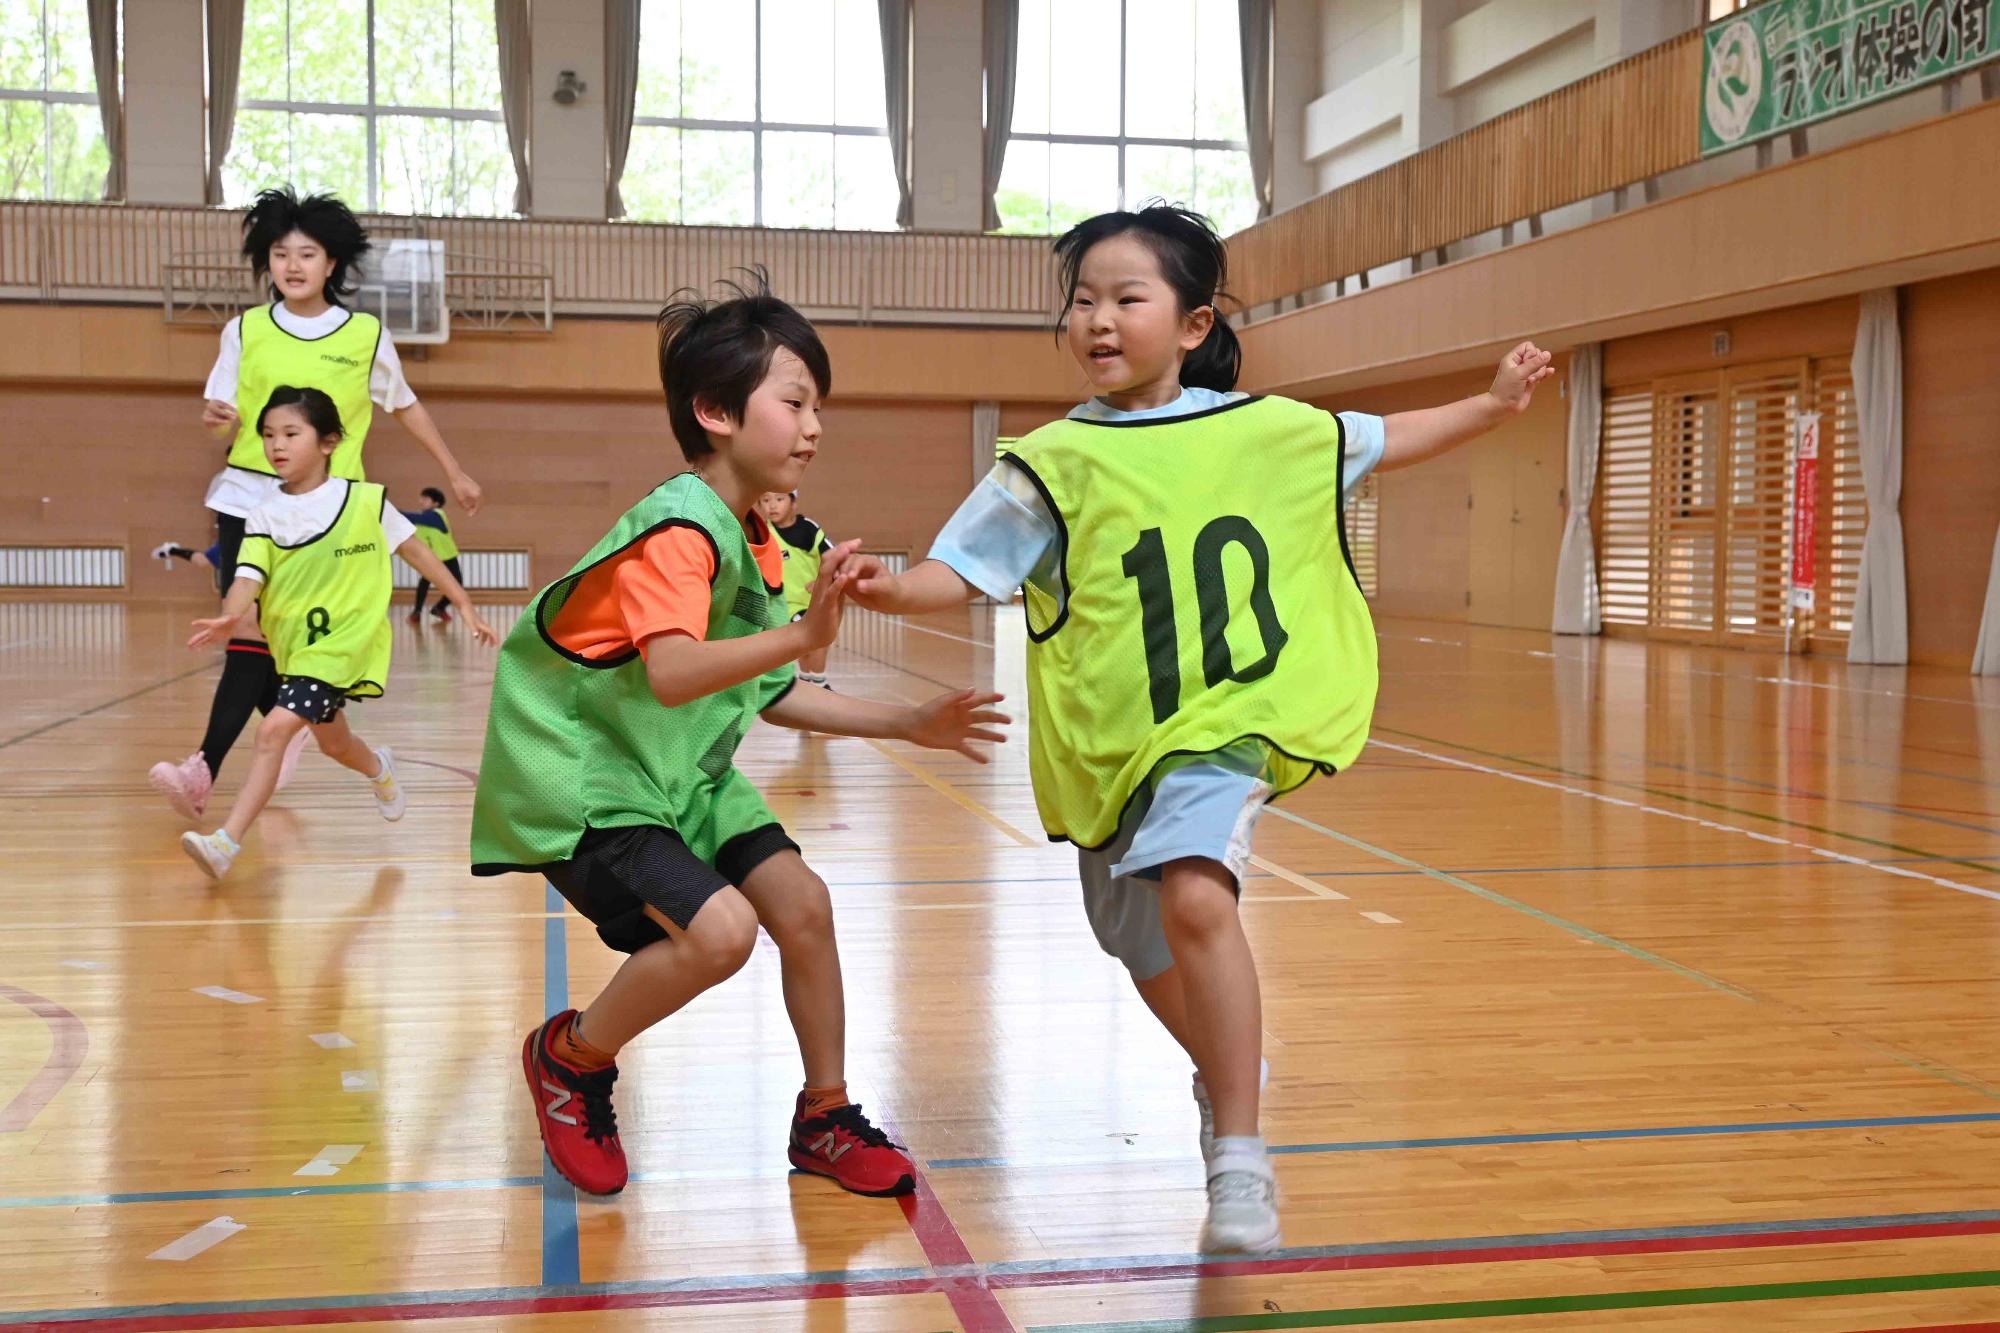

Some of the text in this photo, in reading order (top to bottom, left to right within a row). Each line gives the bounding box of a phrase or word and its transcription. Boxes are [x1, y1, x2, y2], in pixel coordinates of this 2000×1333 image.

[320, 354, 359, 367] molten
[335, 543, 376, 557] molten
[307, 607, 331, 646] 8
[1121, 515, 1289, 725] 10
[542, 1080, 577, 1126] N
[809, 1131, 853, 1163] N
